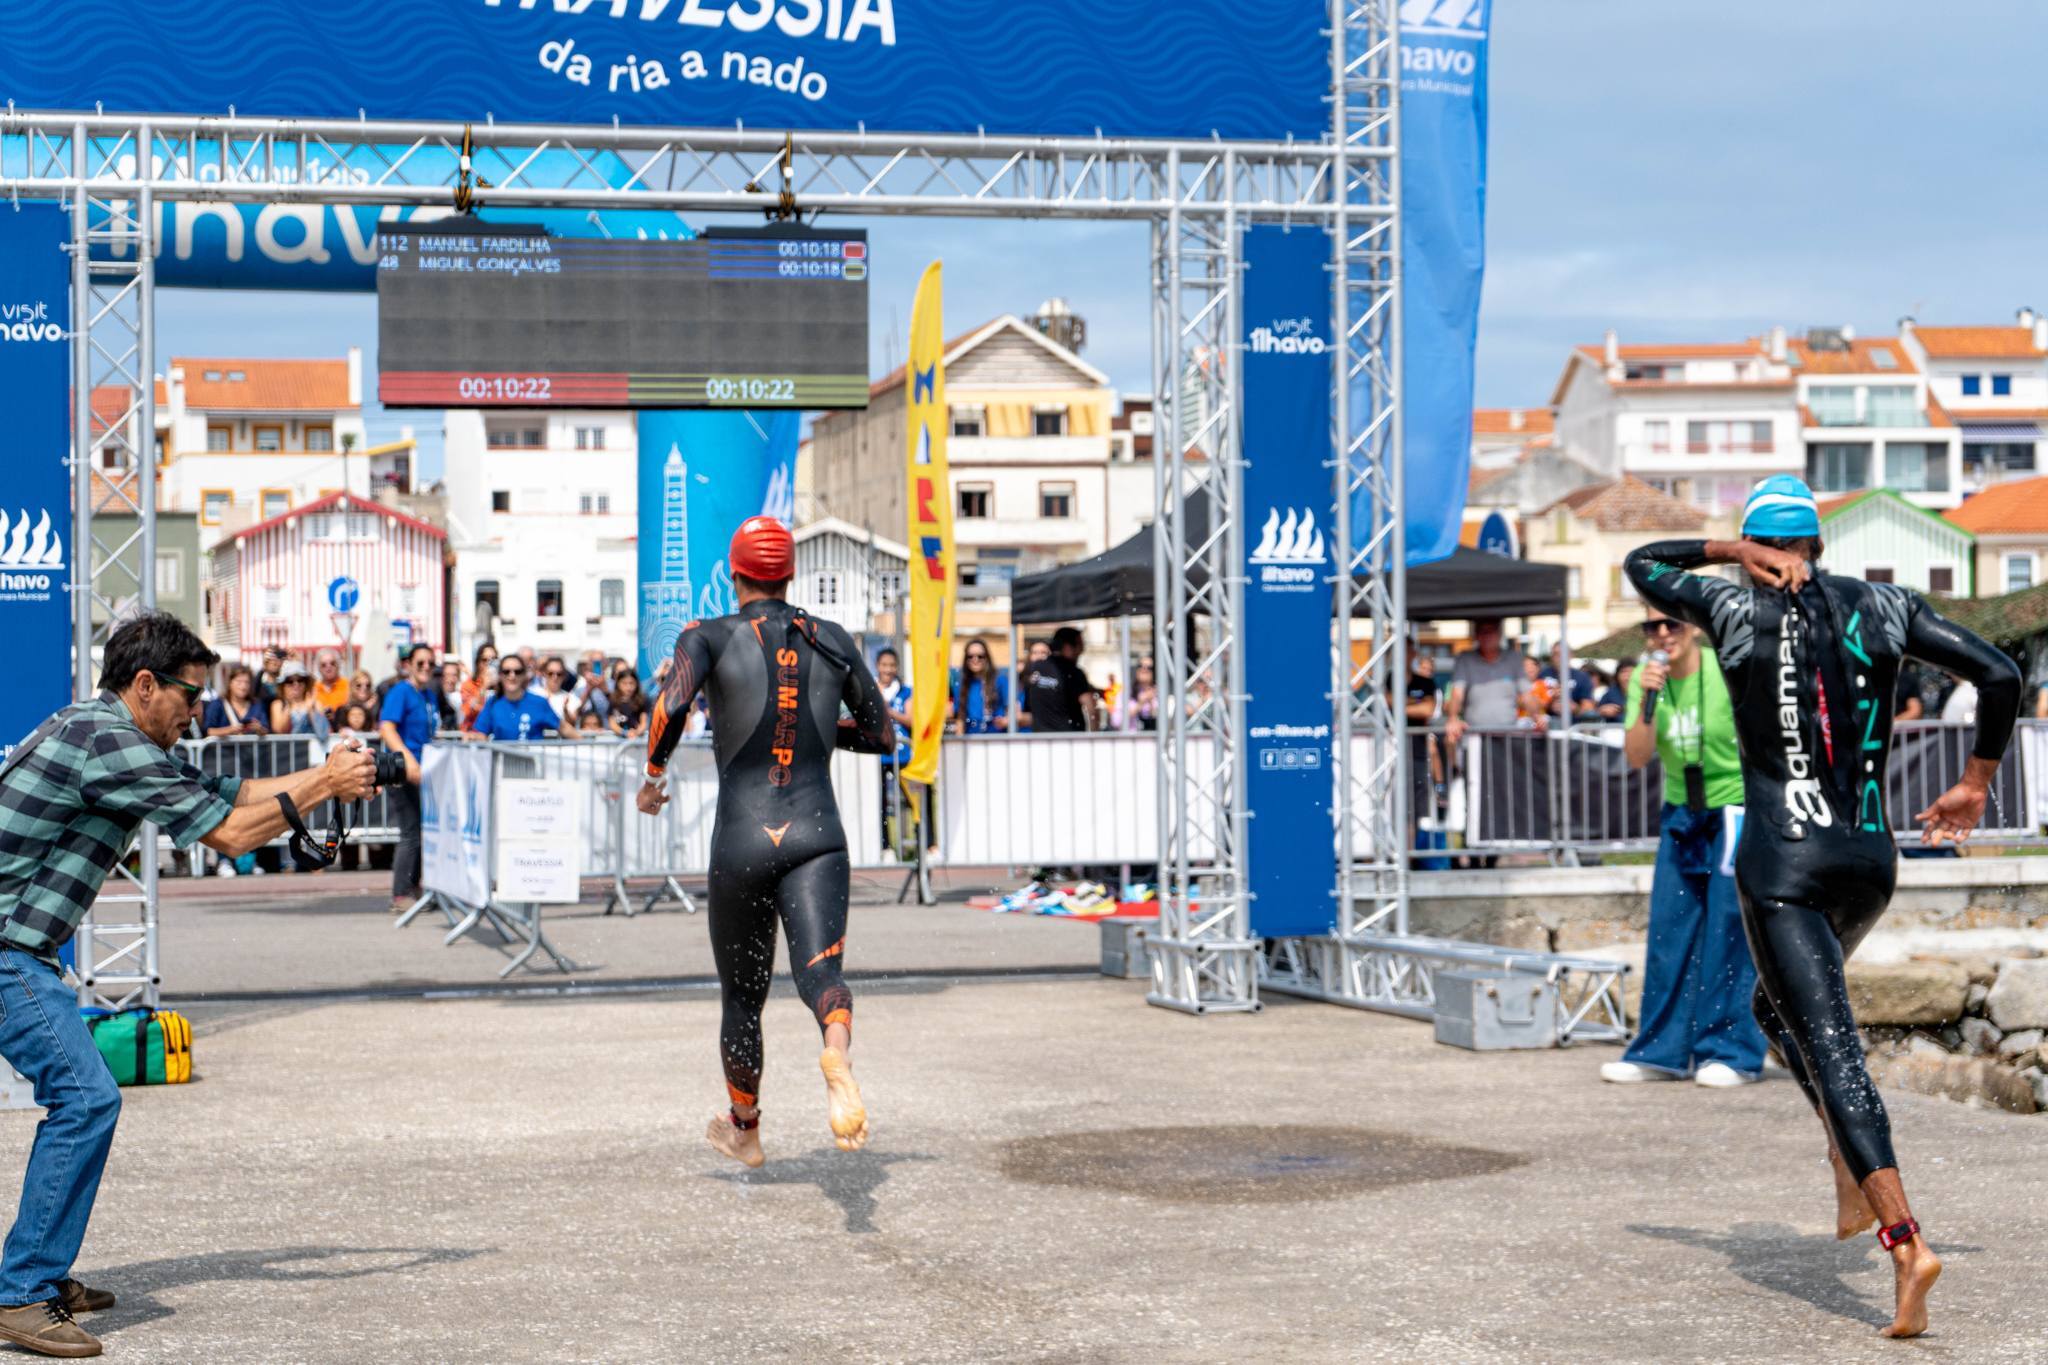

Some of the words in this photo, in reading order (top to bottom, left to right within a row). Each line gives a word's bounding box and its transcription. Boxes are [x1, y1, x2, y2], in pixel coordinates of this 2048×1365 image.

[538, 38, 592, 86] da
[608, 54, 670, 93] ria
[680, 49, 708, 81] a
[721, 50, 828, 101] nado
[380, 234, 409, 251] 112
[418, 236, 480, 253] MANUEL
[481, 237, 552, 253] FARDILHA
[380, 255, 400, 270] 48
[418, 255, 474, 272] MIGUEL
[476, 257, 562, 277] GONÇALVES
[2, 300, 48, 324] visit
[459, 377, 552, 400] 00:10:22
[706, 378, 795, 401] 00:10:22
[768, 647, 800, 788] SUMARPO
